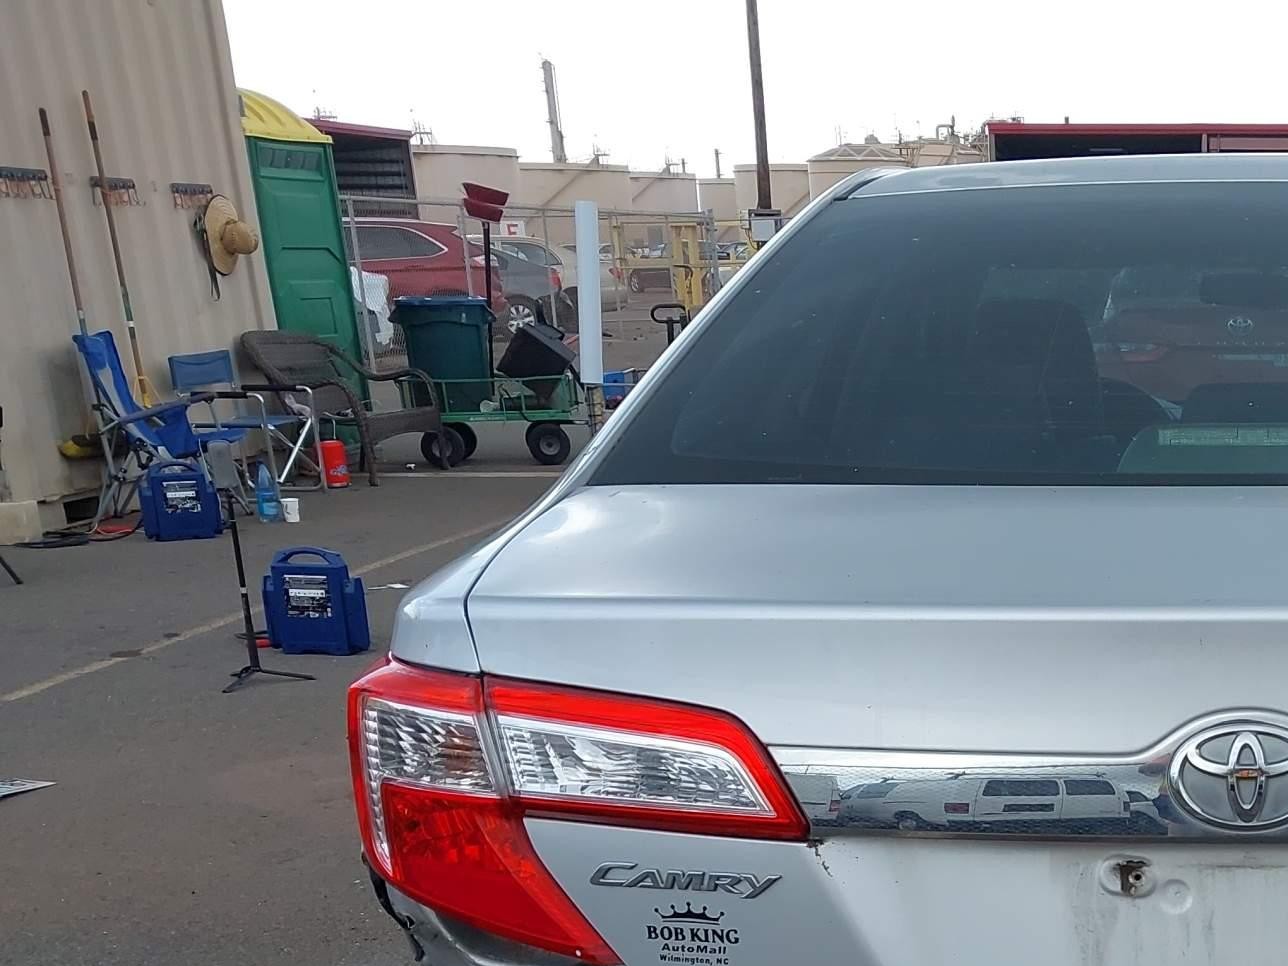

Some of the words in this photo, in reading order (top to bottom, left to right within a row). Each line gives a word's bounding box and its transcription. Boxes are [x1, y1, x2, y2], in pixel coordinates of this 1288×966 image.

[588, 861, 783, 899] CAMRY
[646, 925, 686, 942] BOB
[689, 928, 740, 944] KING
[661, 943, 727, 955] AutoMall
[659, 953, 713, 966] Wilmington,
[716, 957, 729, 966] NC
